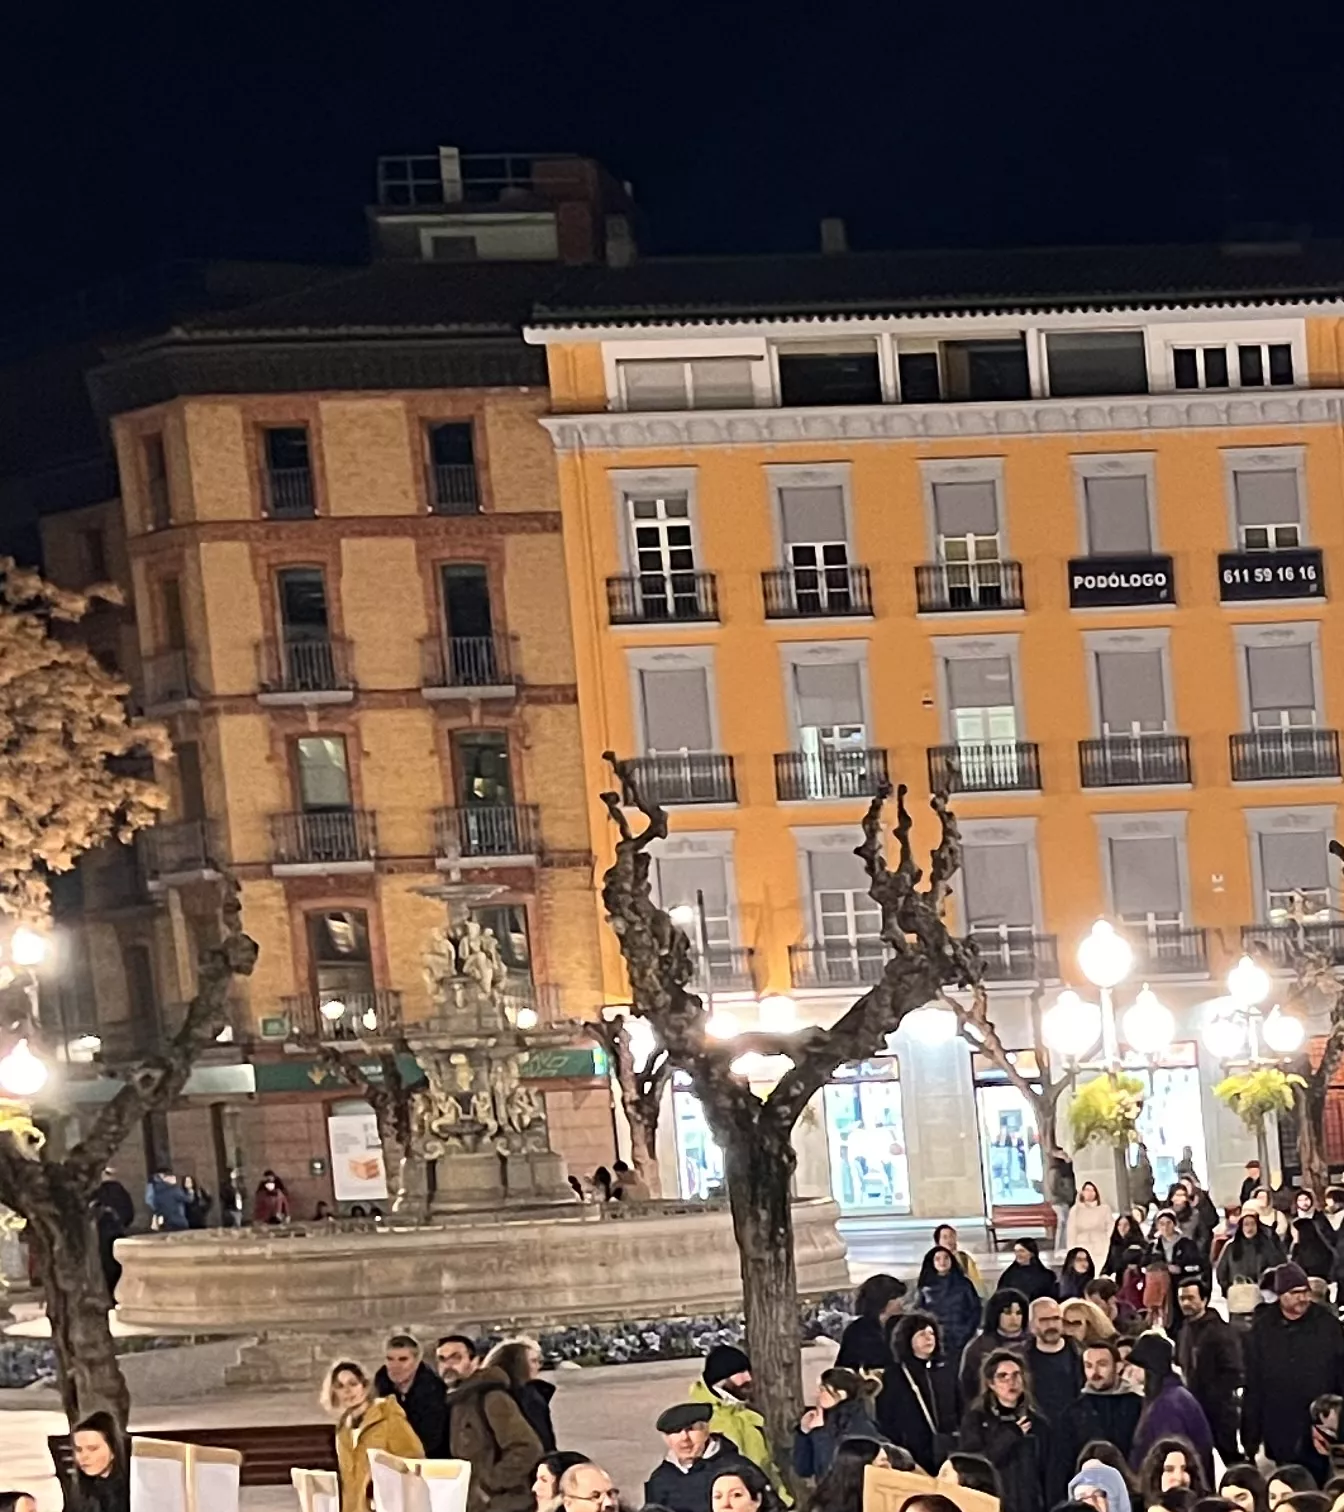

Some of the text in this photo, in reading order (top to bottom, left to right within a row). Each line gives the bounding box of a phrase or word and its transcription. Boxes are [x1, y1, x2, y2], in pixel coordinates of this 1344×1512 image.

[1073, 572, 1167, 589] PODÓLOGO
[1223, 565, 1317, 584] 611 59 16 16
